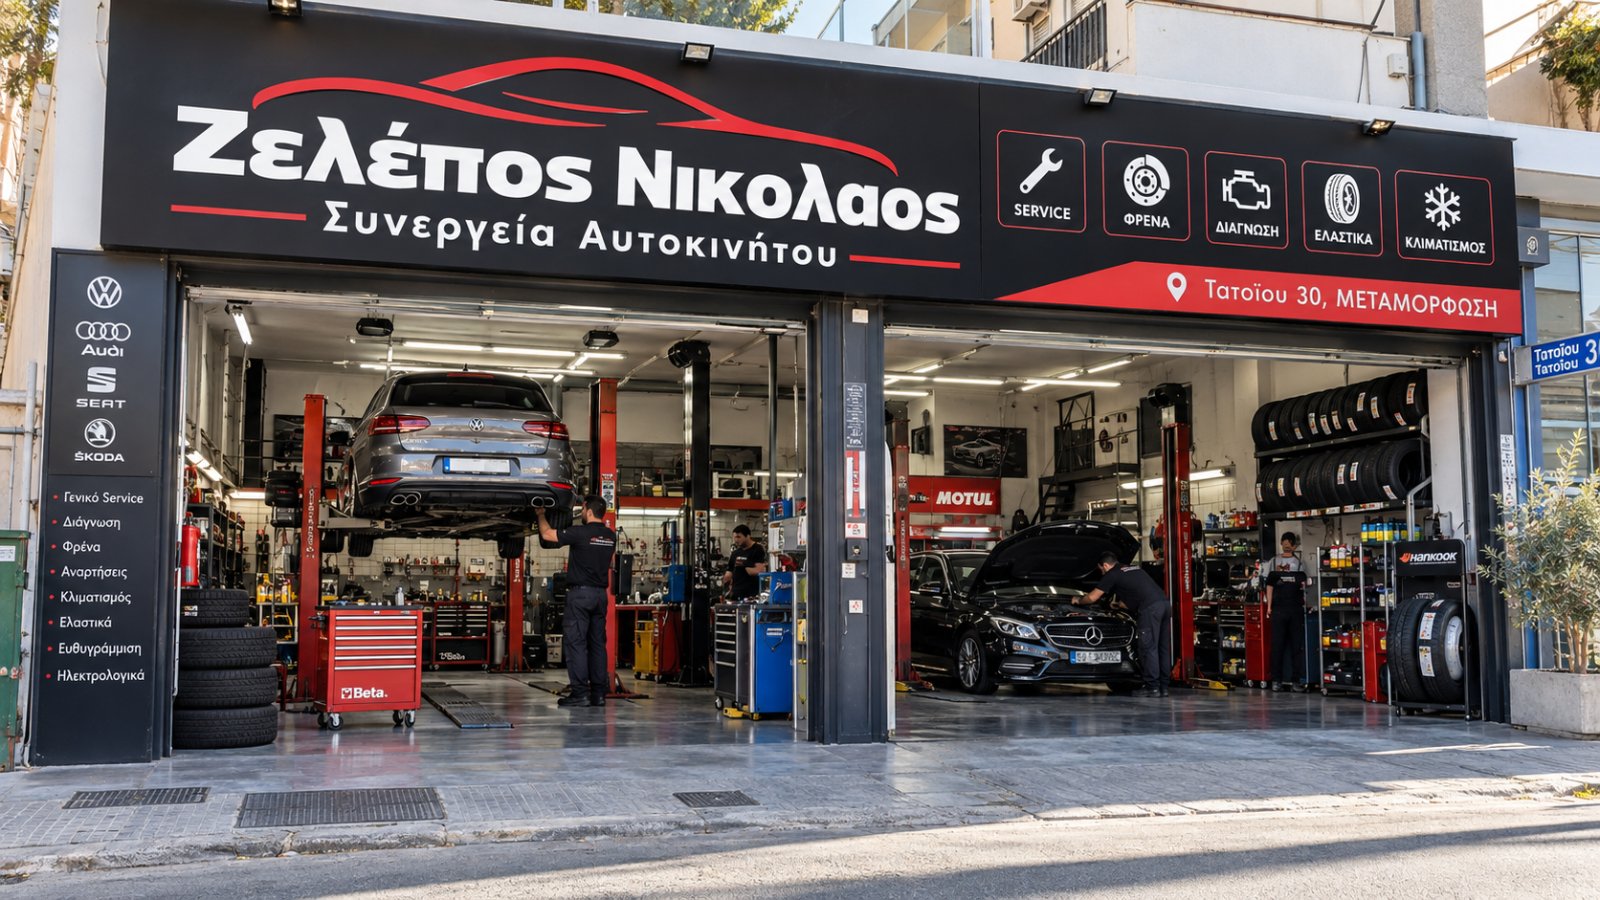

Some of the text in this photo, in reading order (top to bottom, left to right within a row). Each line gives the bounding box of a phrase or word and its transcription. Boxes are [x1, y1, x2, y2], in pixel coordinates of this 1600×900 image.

[172, 105, 961, 235] Ζελέπος Νικολαος
[1014, 203, 1071, 220] SERVICE
[1123, 213, 1171, 229] ΦΡΕΝΑ
[1215, 220, 1280, 238] ΔΙΑΓΝΩΣΗ
[323, 200, 837, 268] Συνεργεία Αυτοκινήτου
[1314, 229, 1374, 246] ΕΛΑΣΤΙΚΑ
[1405, 236, 1487, 254] ΚΛΙΜΑΤΙΣΜΟΣ
[1297, 286, 1328, 309] 30,
[1336, 288, 1498, 318] ΜΕΤΑΜΟΡΦΩΣΗ
[81, 344, 124, 357] Audi
[1585, 338, 1600, 365] 3
[75, 398, 127, 409] SEAT
[74, 450, 125, 463] ŠKODA
[63, 491, 144, 504] Γενικό Service
[935, 490, 994, 506] MOTUL
[62, 515, 121, 531] Διάγνωση
[62, 540, 101, 555] Φρένα
[60, 565, 128, 580] Αναρτήσεις
[60, 590, 132, 606] Κλιματισμός
[59, 615, 112, 629] Ελαστικά
[58, 641, 142, 658] Ευθυγράμμιση
[57, 668, 145, 685] Ηλεκτρολογικά
